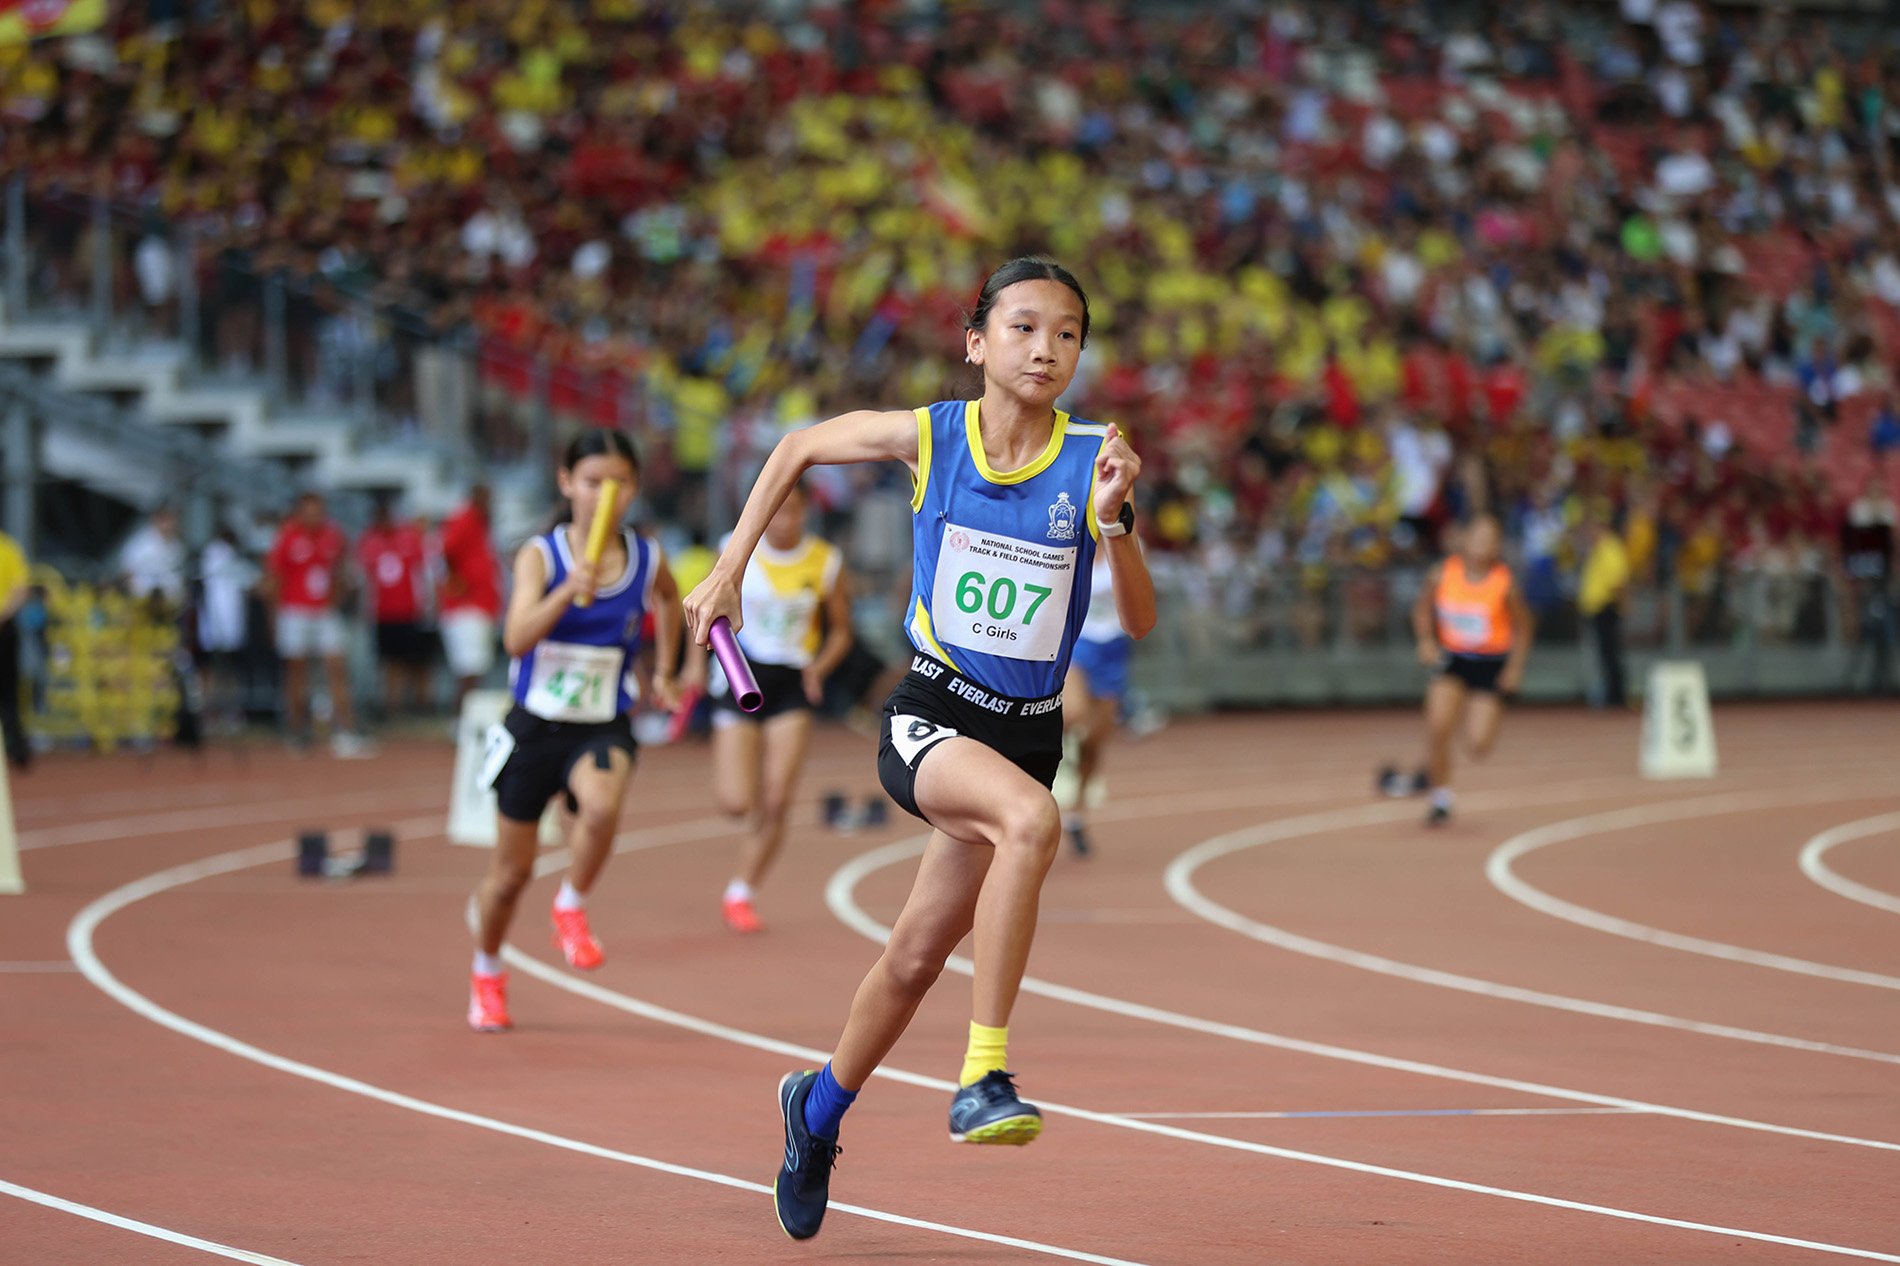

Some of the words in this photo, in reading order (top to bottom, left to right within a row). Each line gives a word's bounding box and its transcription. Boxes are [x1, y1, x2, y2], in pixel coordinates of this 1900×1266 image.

[969, 546, 991, 557] TRACK
[999, 553, 1018, 562] FIELD
[1019, 557, 1071, 571] CHAMPIONSHIPS
[980, 538, 1013, 552] NATIONAL
[1014, 546, 1041, 558] SCHOOL
[1042, 553, 1065, 562] GAMES
[955, 571, 1053, 626] 607
[972, 622, 983, 634] C
[986, 624, 1018, 641] Girls
[545, 668, 604, 708] 421
[947, 677, 1014, 715] EVERLAST
